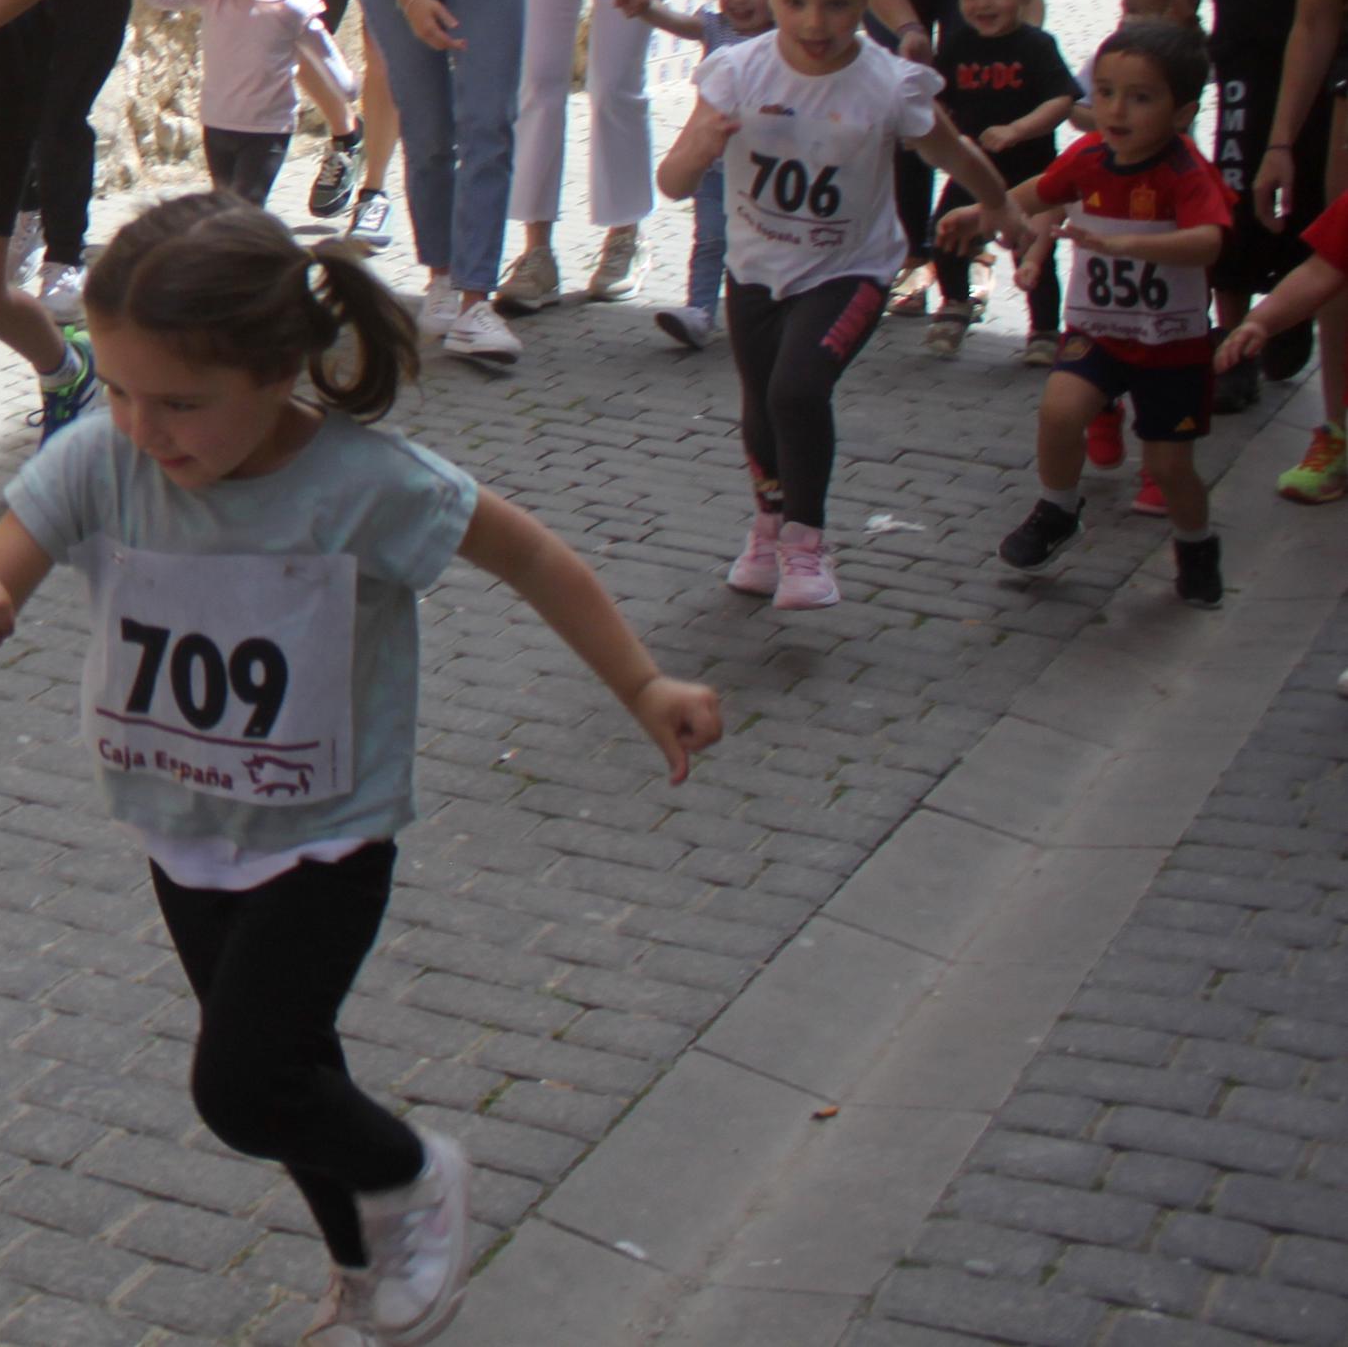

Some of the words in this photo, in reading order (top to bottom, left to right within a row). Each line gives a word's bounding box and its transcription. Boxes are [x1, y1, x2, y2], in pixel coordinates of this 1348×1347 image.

[1221, 80, 1246, 191] OMAR
[750, 152, 841, 218] 706
[1087, 256, 1168, 310] 856
[121, 616, 288, 738] 709
[98, 738, 146, 771] Caja
[154, 750, 234, 790] España
